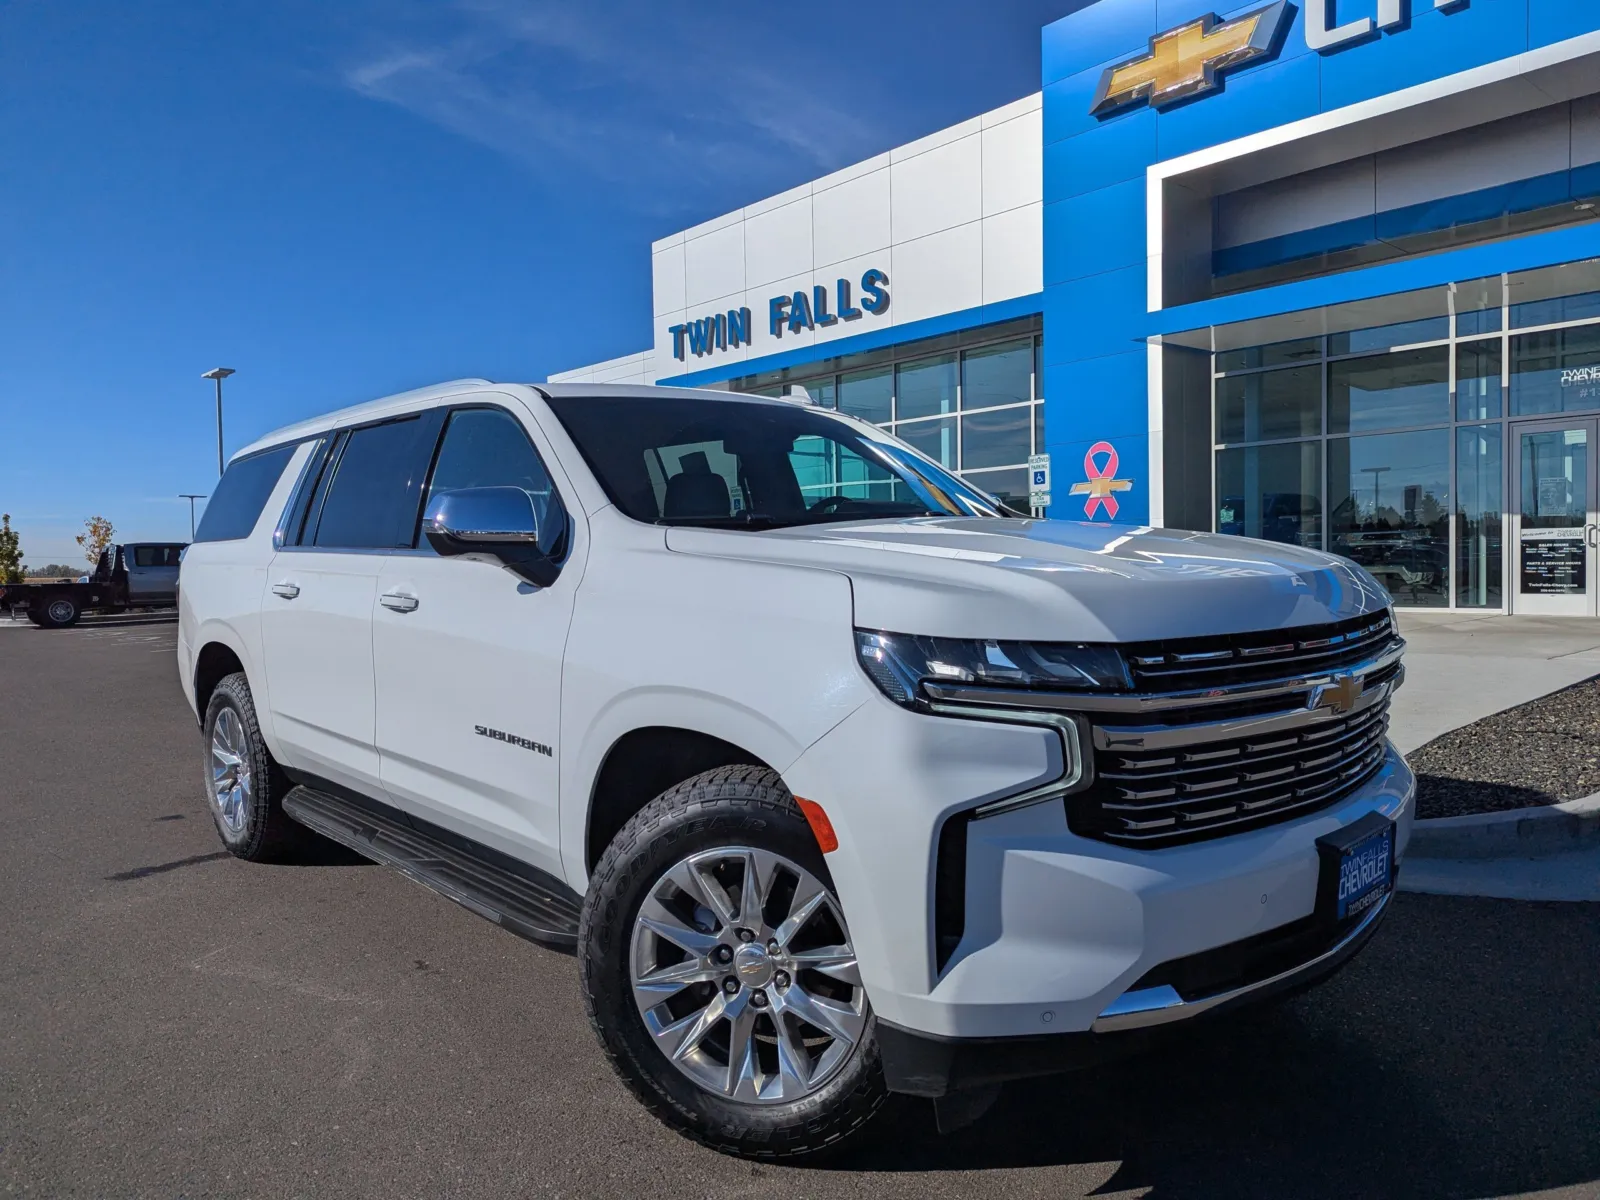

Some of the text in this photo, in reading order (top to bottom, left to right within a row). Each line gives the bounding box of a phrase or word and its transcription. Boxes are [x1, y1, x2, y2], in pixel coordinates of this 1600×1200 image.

[669, 268, 890, 362] TWIN FALLS
[474, 724, 553, 758] SUBURBAN
[1338, 852, 1389, 901] CHEVROLET
